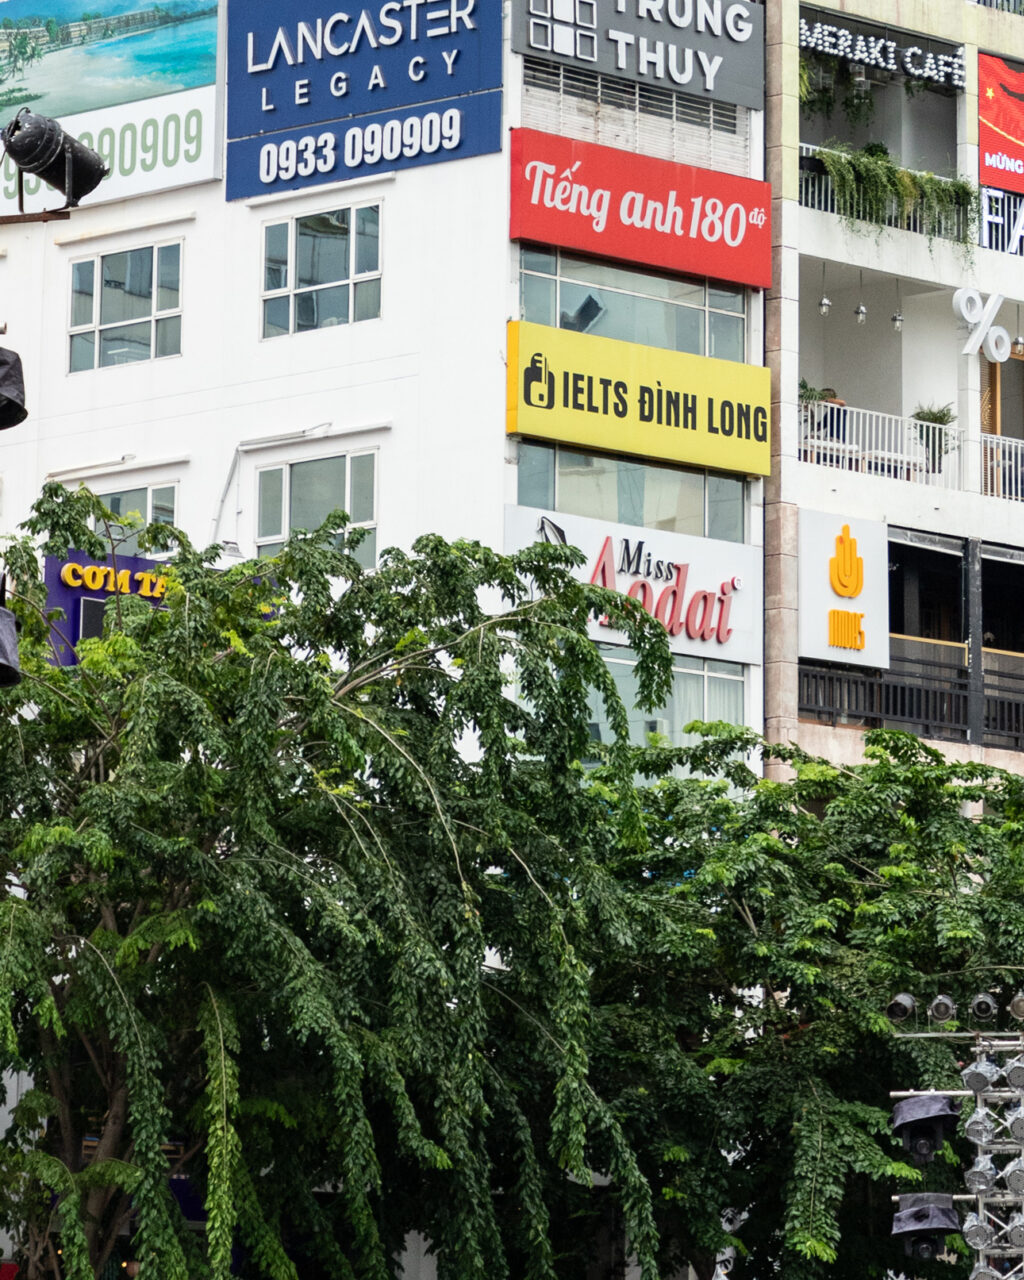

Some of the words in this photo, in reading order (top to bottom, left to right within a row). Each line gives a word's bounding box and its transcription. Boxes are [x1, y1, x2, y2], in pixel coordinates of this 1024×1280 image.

[261, 49, 459, 111] LEGACY
[608, 29, 724, 91] THUY
[259, 132, 336, 184] 0933
[344, 108, 461, 168] 090909
[525, 161, 611, 233] Tiếng
[688, 195, 747, 247] 180
[748, 208, 768, 229] độ
[562, 370, 628, 419] IELTS
[638, 380, 697, 431] ĐÌNH
[707, 397, 768, 442] LONG
[618, 538, 675, 582] Miss
